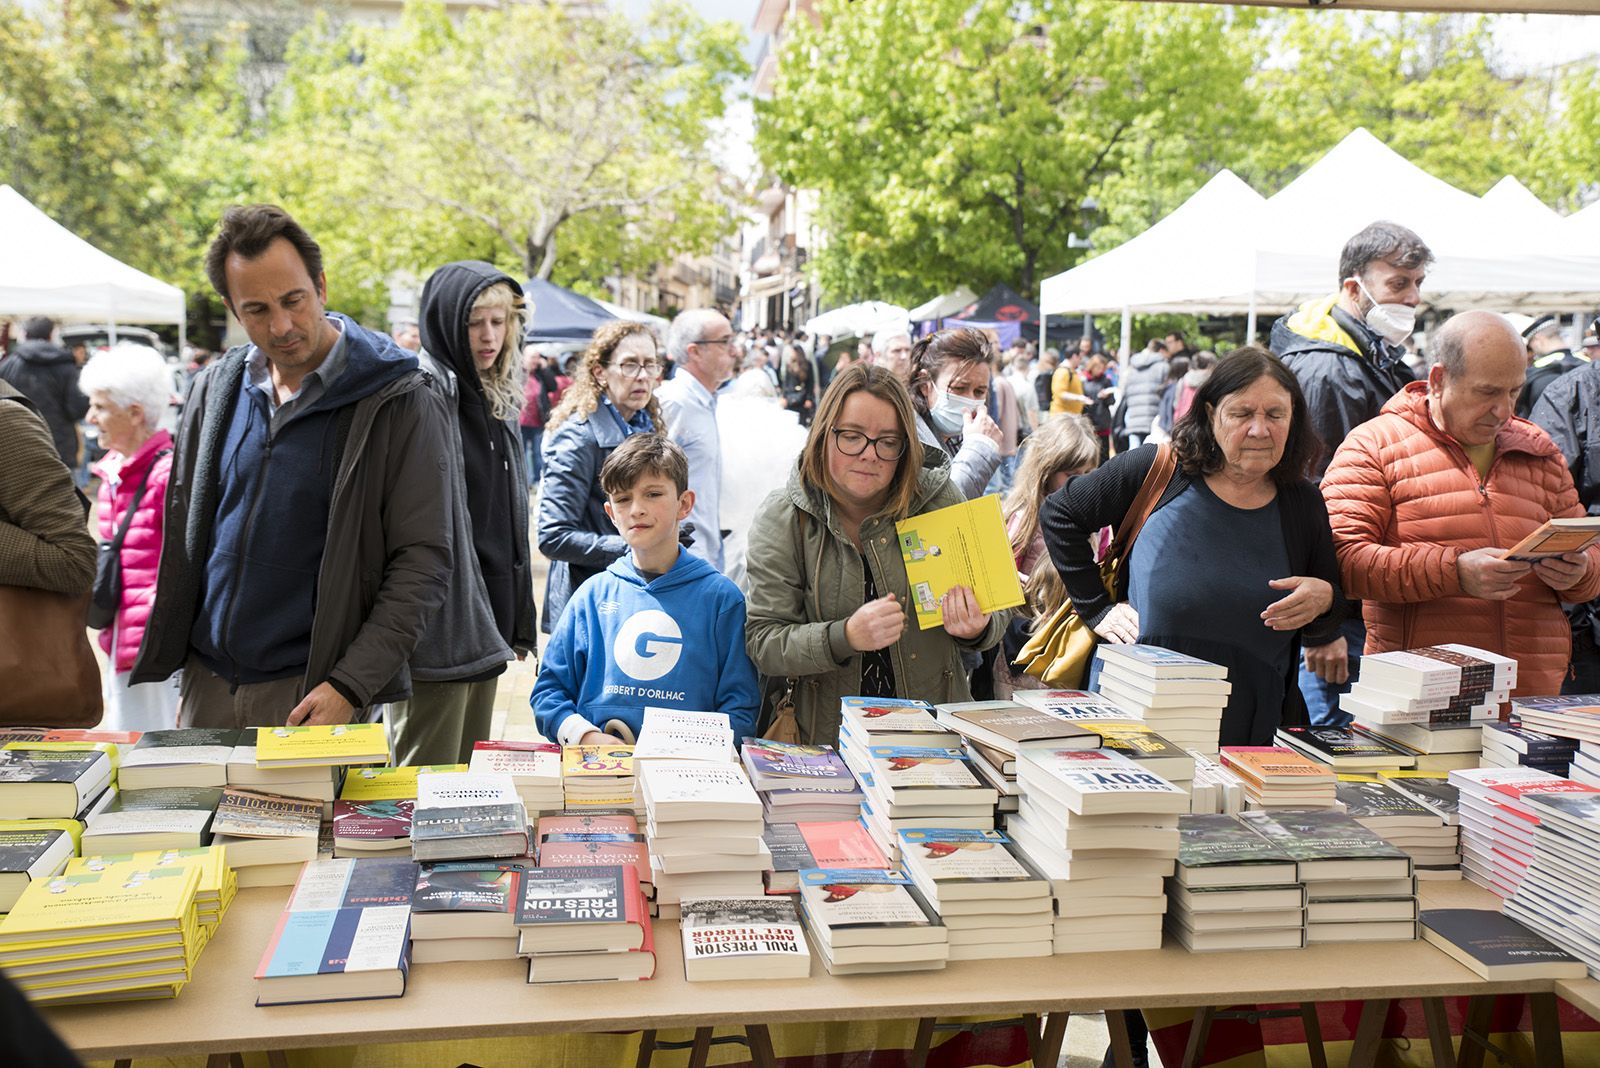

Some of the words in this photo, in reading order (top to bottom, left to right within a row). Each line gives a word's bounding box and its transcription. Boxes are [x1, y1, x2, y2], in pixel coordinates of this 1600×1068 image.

[638, 687, 686, 701] D'ORLHAC
[1049, 706, 1127, 716] BOYE
[772, 766, 838, 777] CIÈNCIA
[1066, 773, 1165, 785] BOYE
[1089, 784, 1173, 792] Gonzalo
[416, 815, 517, 826] Barcelona
[548, 853, 640, 861] HUMANITAT
[524, 898, 617, 910] PRESTON
[564, 908, 618, 918] PAUL
[691, 928, 754, 938] TERROR
[692, 934, 795, 944] ARQUITECTES
[694, 942, 758, 955] PRESTON
[761, 940, 799, 953] PAUL
